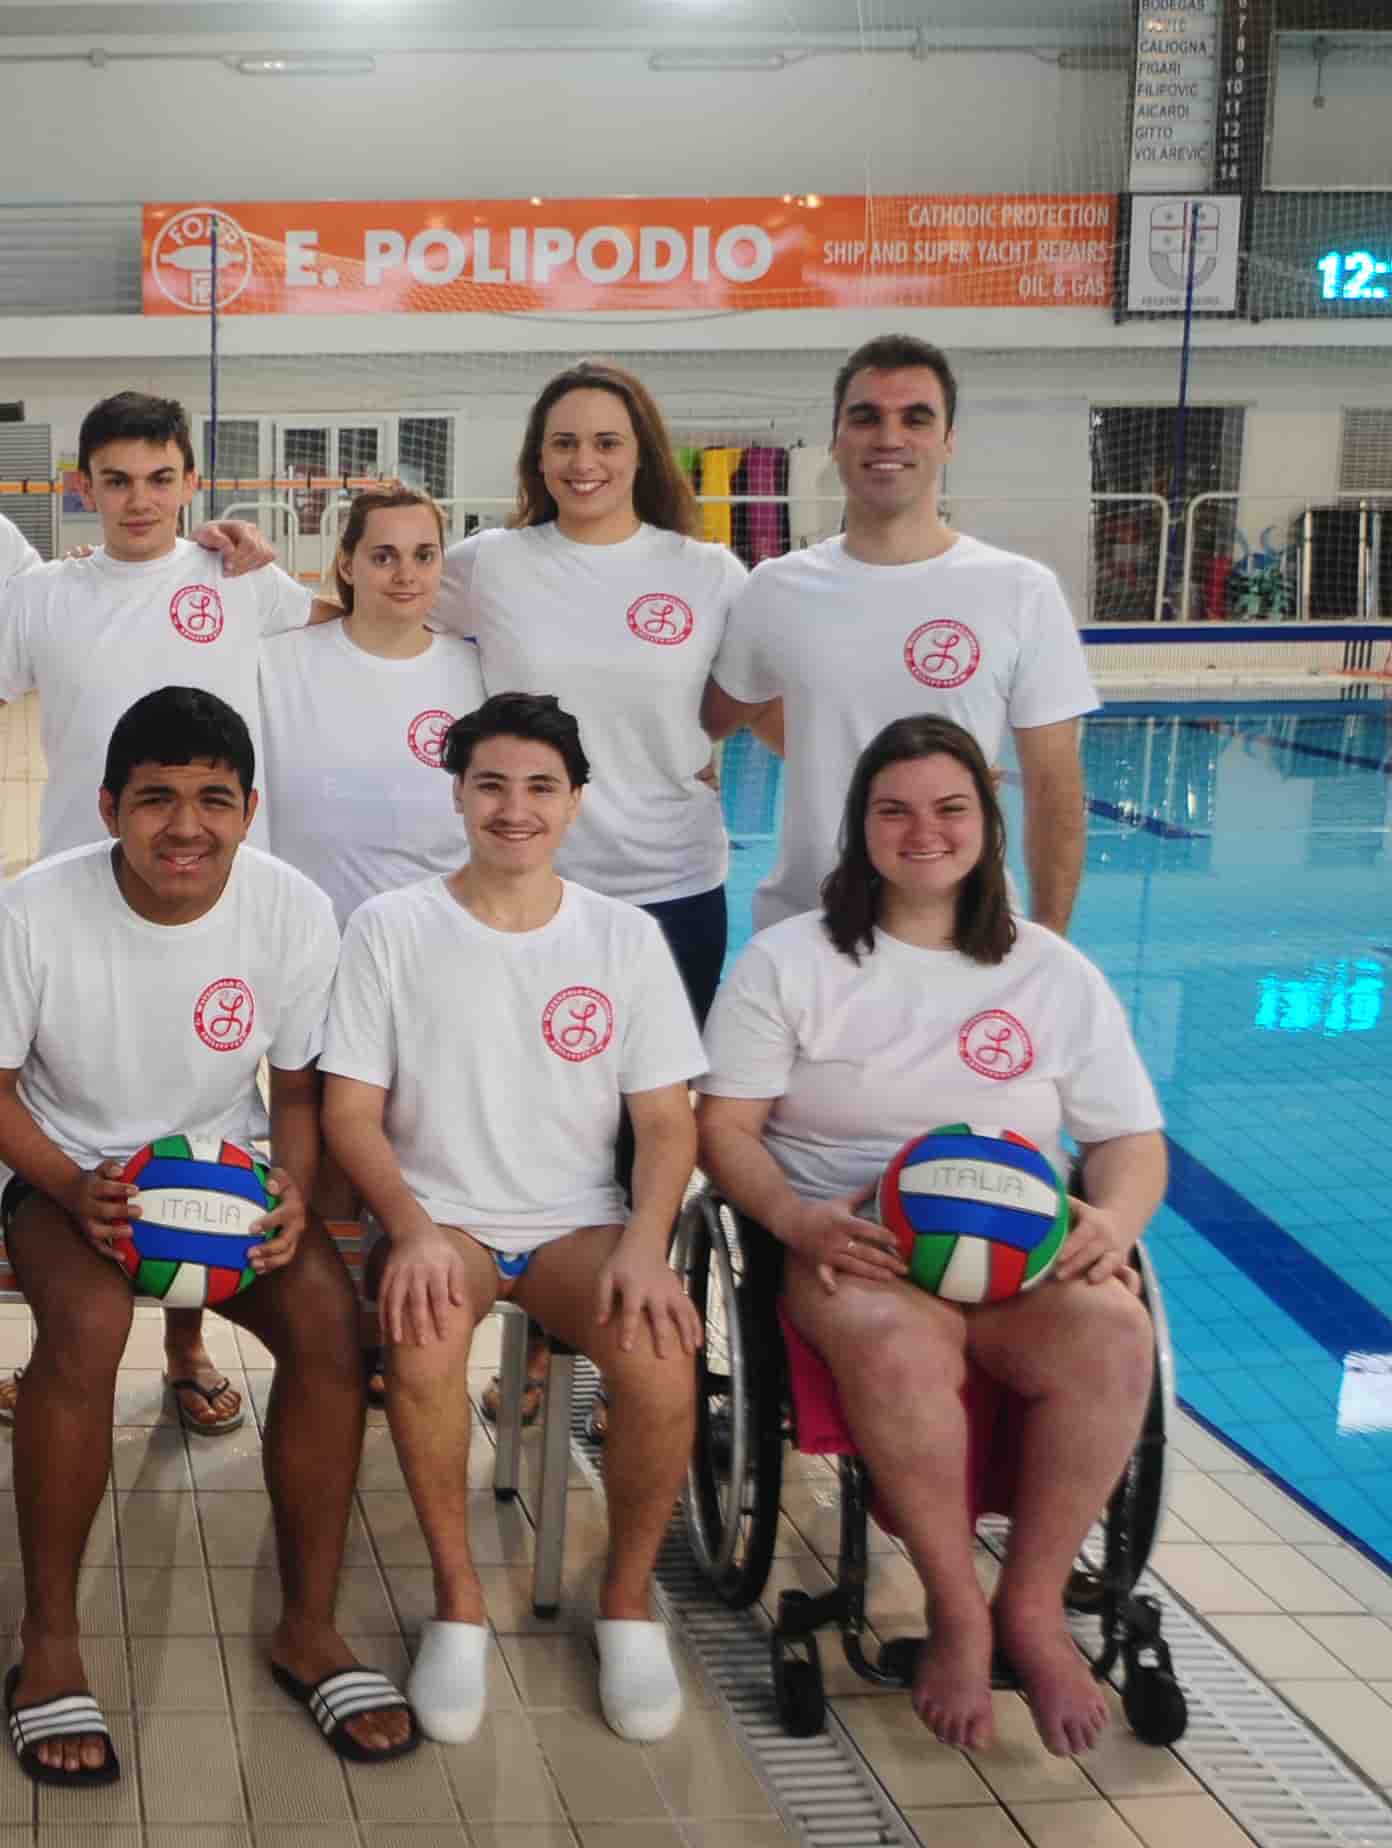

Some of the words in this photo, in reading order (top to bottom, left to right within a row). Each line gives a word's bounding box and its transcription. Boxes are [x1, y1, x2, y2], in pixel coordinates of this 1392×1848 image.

[909, 205, 993, 227] CATHODIC
[1002, 205, 1109, 227] PROTECTION
[285, 231, 339, 288] E.
[365, 224, 774, 285] POLIPODIO
[824, 240, 866, 265] SHIP
[870, 240, 906, 264] AND
[912, 239, 971, 264] SUPER
[977, 239, 1032, 265] YACHT
[1038, 239, 1107, 264] REPAIRS
[1019, 275, 1045, 297] OIL
[1072, 275, 1106, 296] GAS
[934, 1167, 1024, 1198] ITALIA
[161, 1199, 241, 1225] ITALIA
